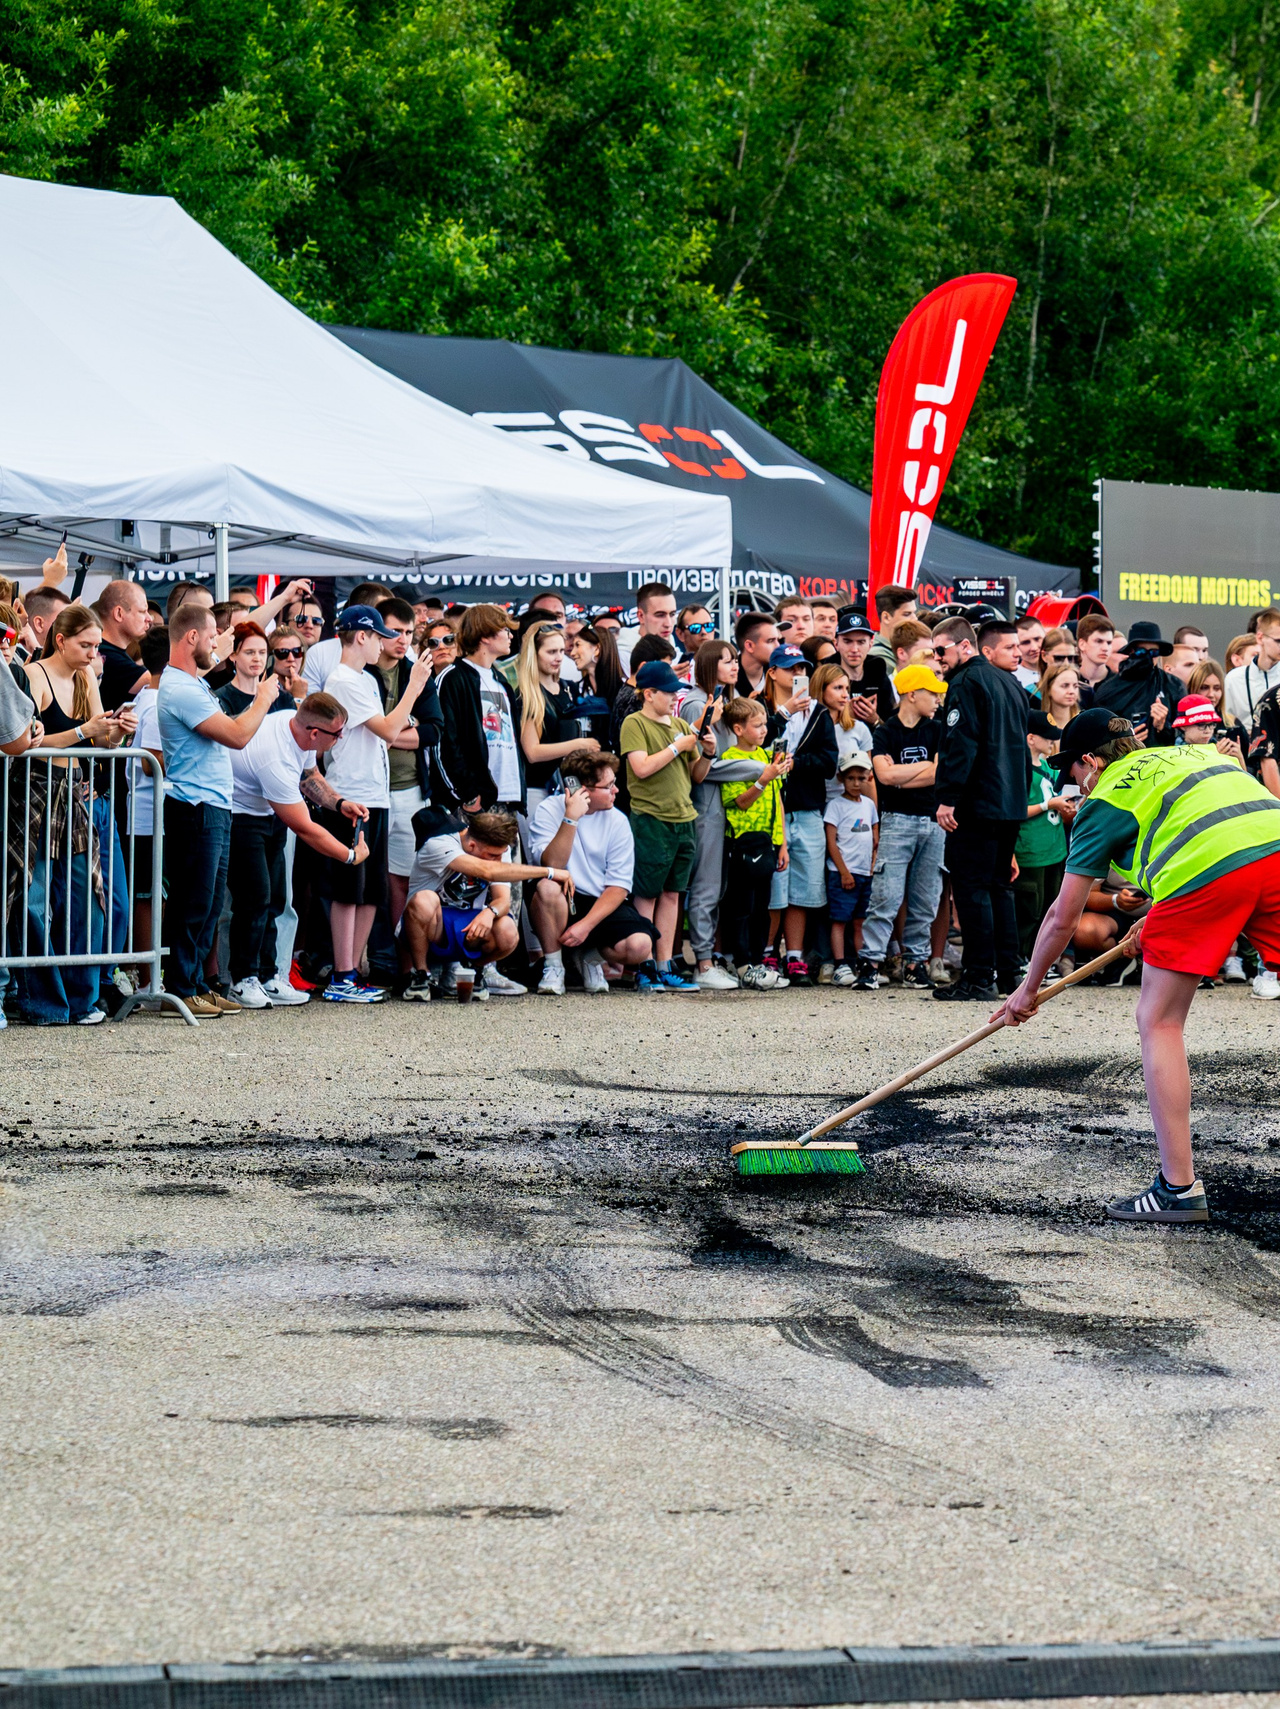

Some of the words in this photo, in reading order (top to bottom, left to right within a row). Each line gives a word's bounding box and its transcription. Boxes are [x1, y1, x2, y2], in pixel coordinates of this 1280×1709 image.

[958, 580, 1005, 590] VISSOL
[1119, 572, 1198, 604] FREEDOM
[1201, 577, 1271, 608] MOTORS
